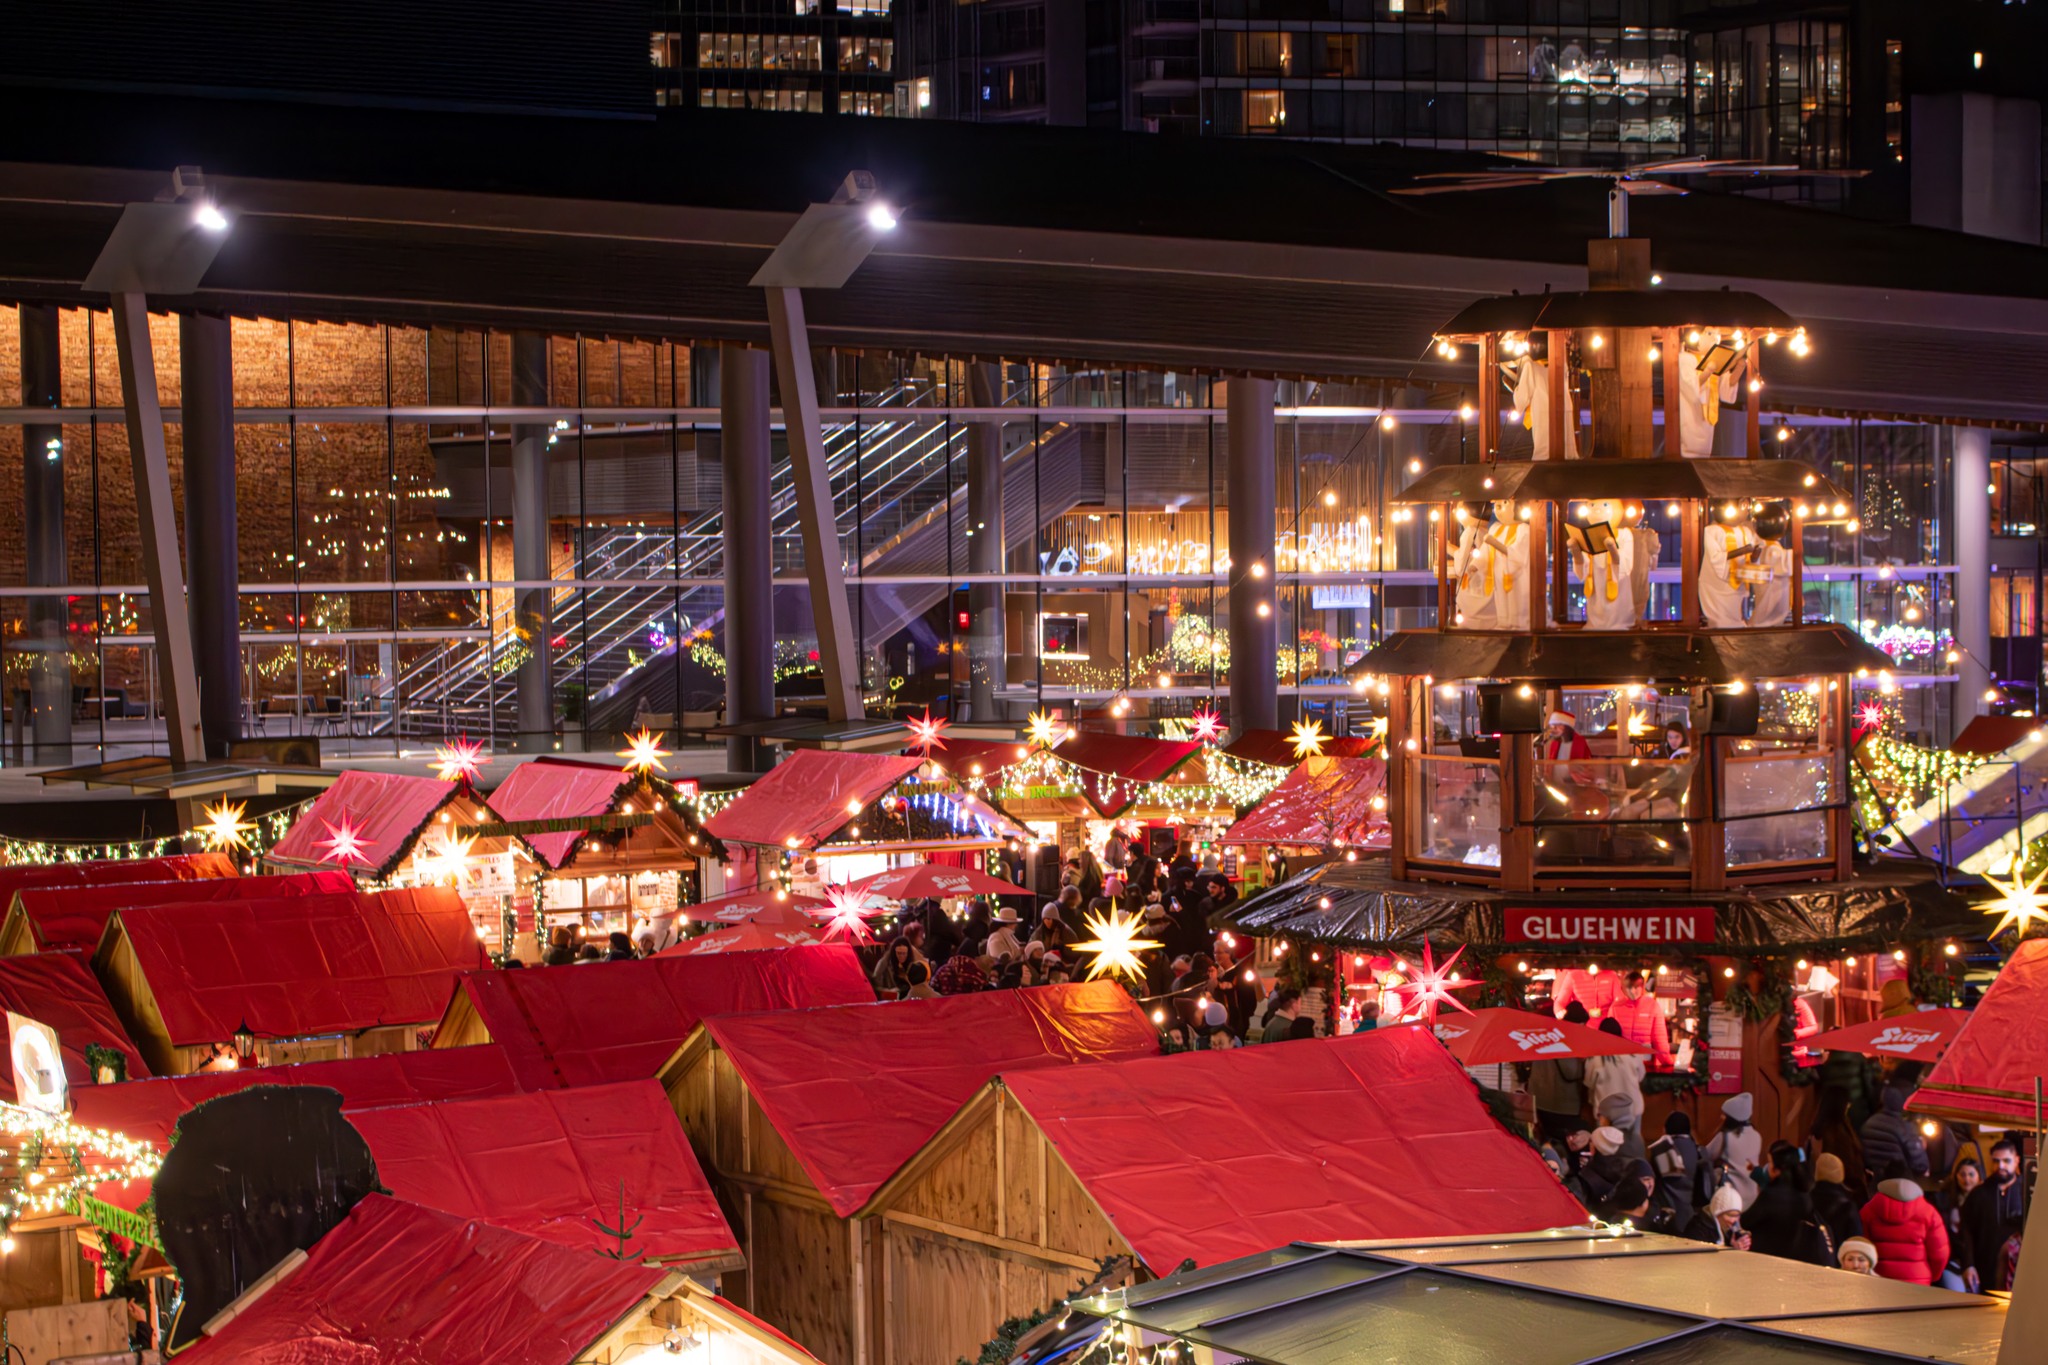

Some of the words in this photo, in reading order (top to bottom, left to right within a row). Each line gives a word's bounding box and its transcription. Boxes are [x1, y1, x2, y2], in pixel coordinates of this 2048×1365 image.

[1522, 915, 1696, 941] GLUEHWEIN
[1508, 1027, 1566, 1051] Stiegl
[1870, 1026, 1942, 1045] Stiegl
[84, 1196, 154, 1248] SCHNITZEL
